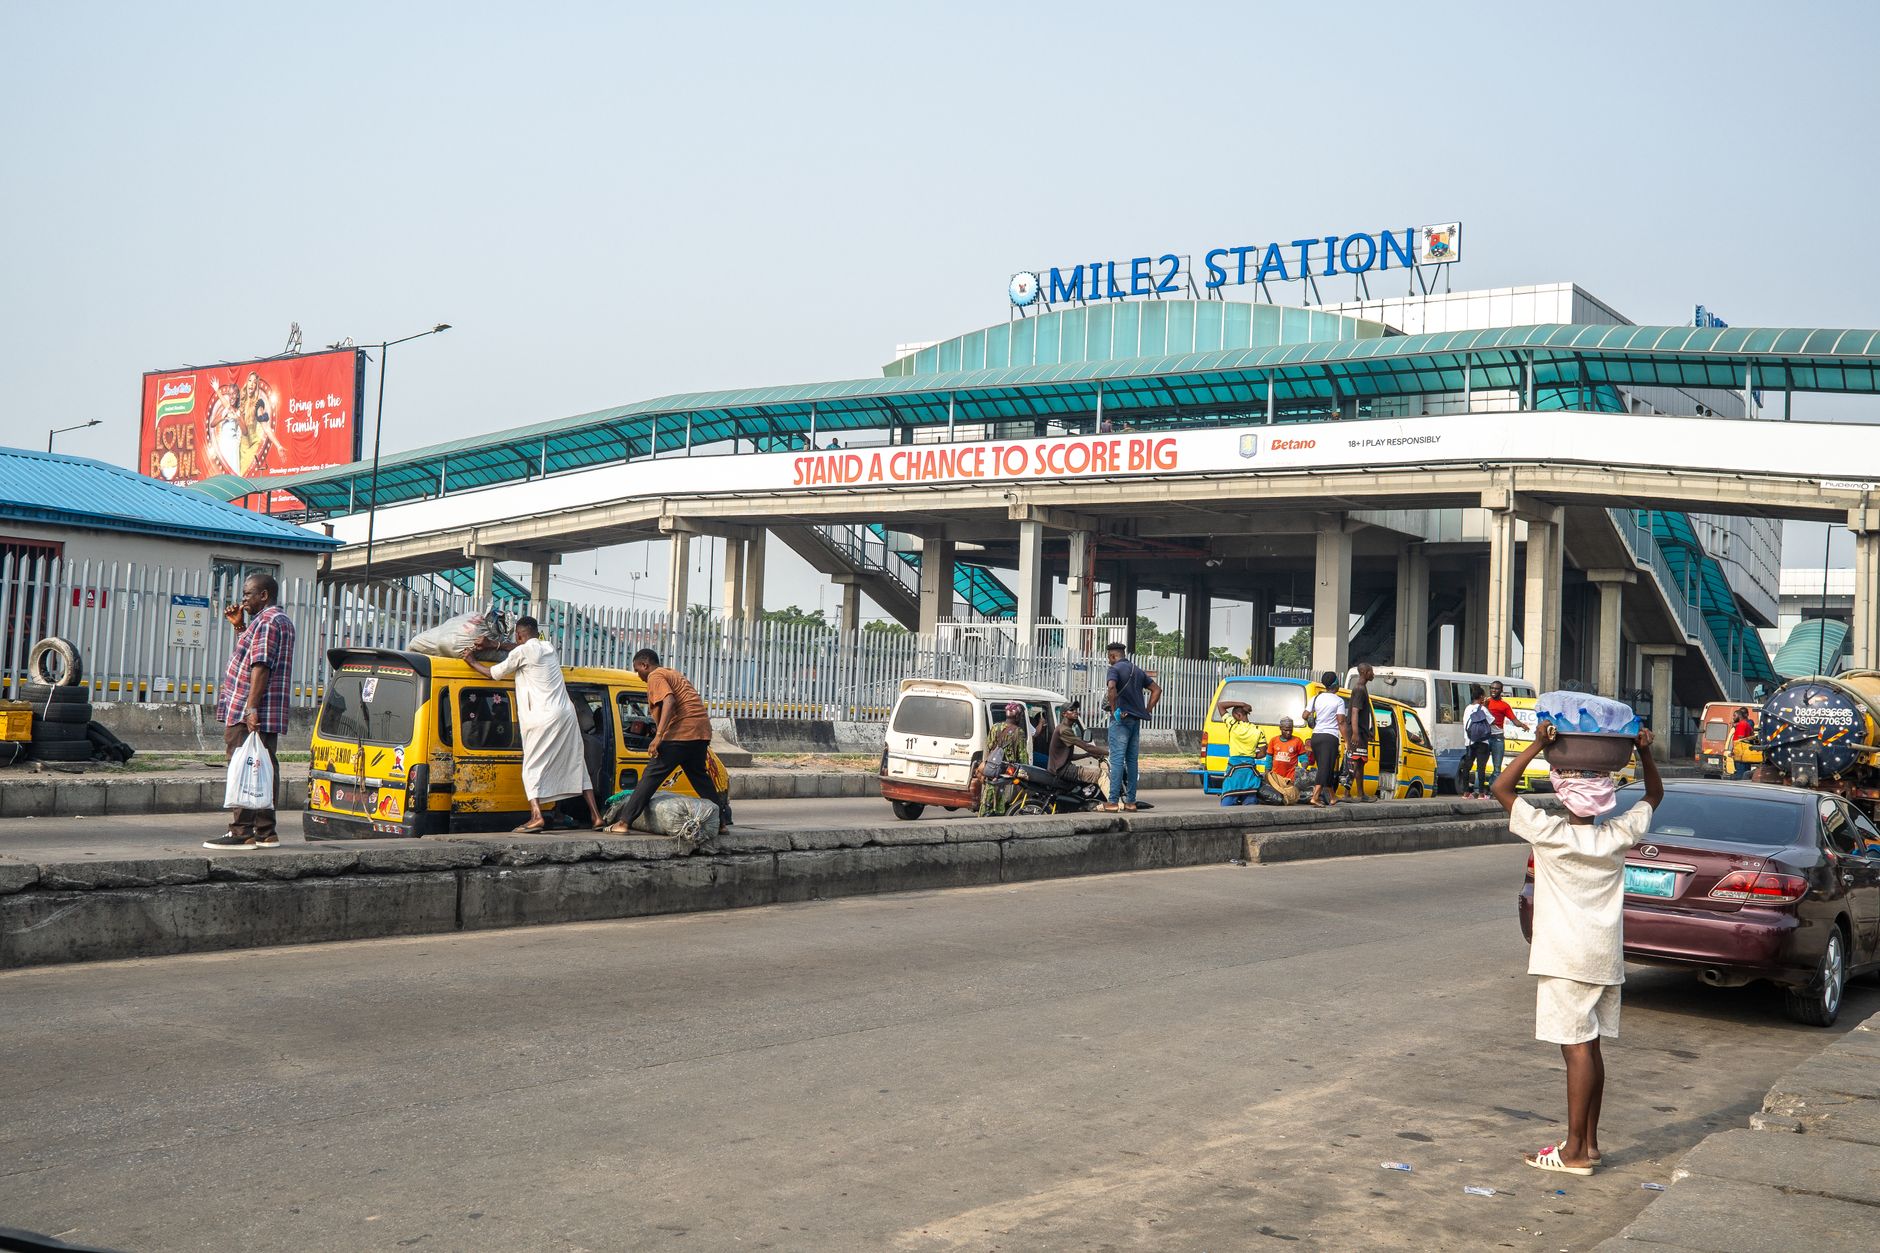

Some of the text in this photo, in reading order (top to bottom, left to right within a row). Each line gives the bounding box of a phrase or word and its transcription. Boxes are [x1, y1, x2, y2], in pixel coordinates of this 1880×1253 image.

[1050, 227, 1415, 304] MILE2 STATION
[289, 393, 342, 417] Bring on the
[285, 410, 346, 438] Family Fun!
[156, 423, 194, 450] LOVE
[1271, 439, 1316, 451] Betano
[1348, 440, 1361, 448] 18+
[1366, 438, 1386, 447] PLAY
[1386, 435, 1441, 446] RESPONSIBLY
[793, 437, 1178, 486] STAND A CHANCE TO SCORE BIG
[1291, 615, 1310, 625] Exit
[1793, 716, 1853, 726] 08057770639
